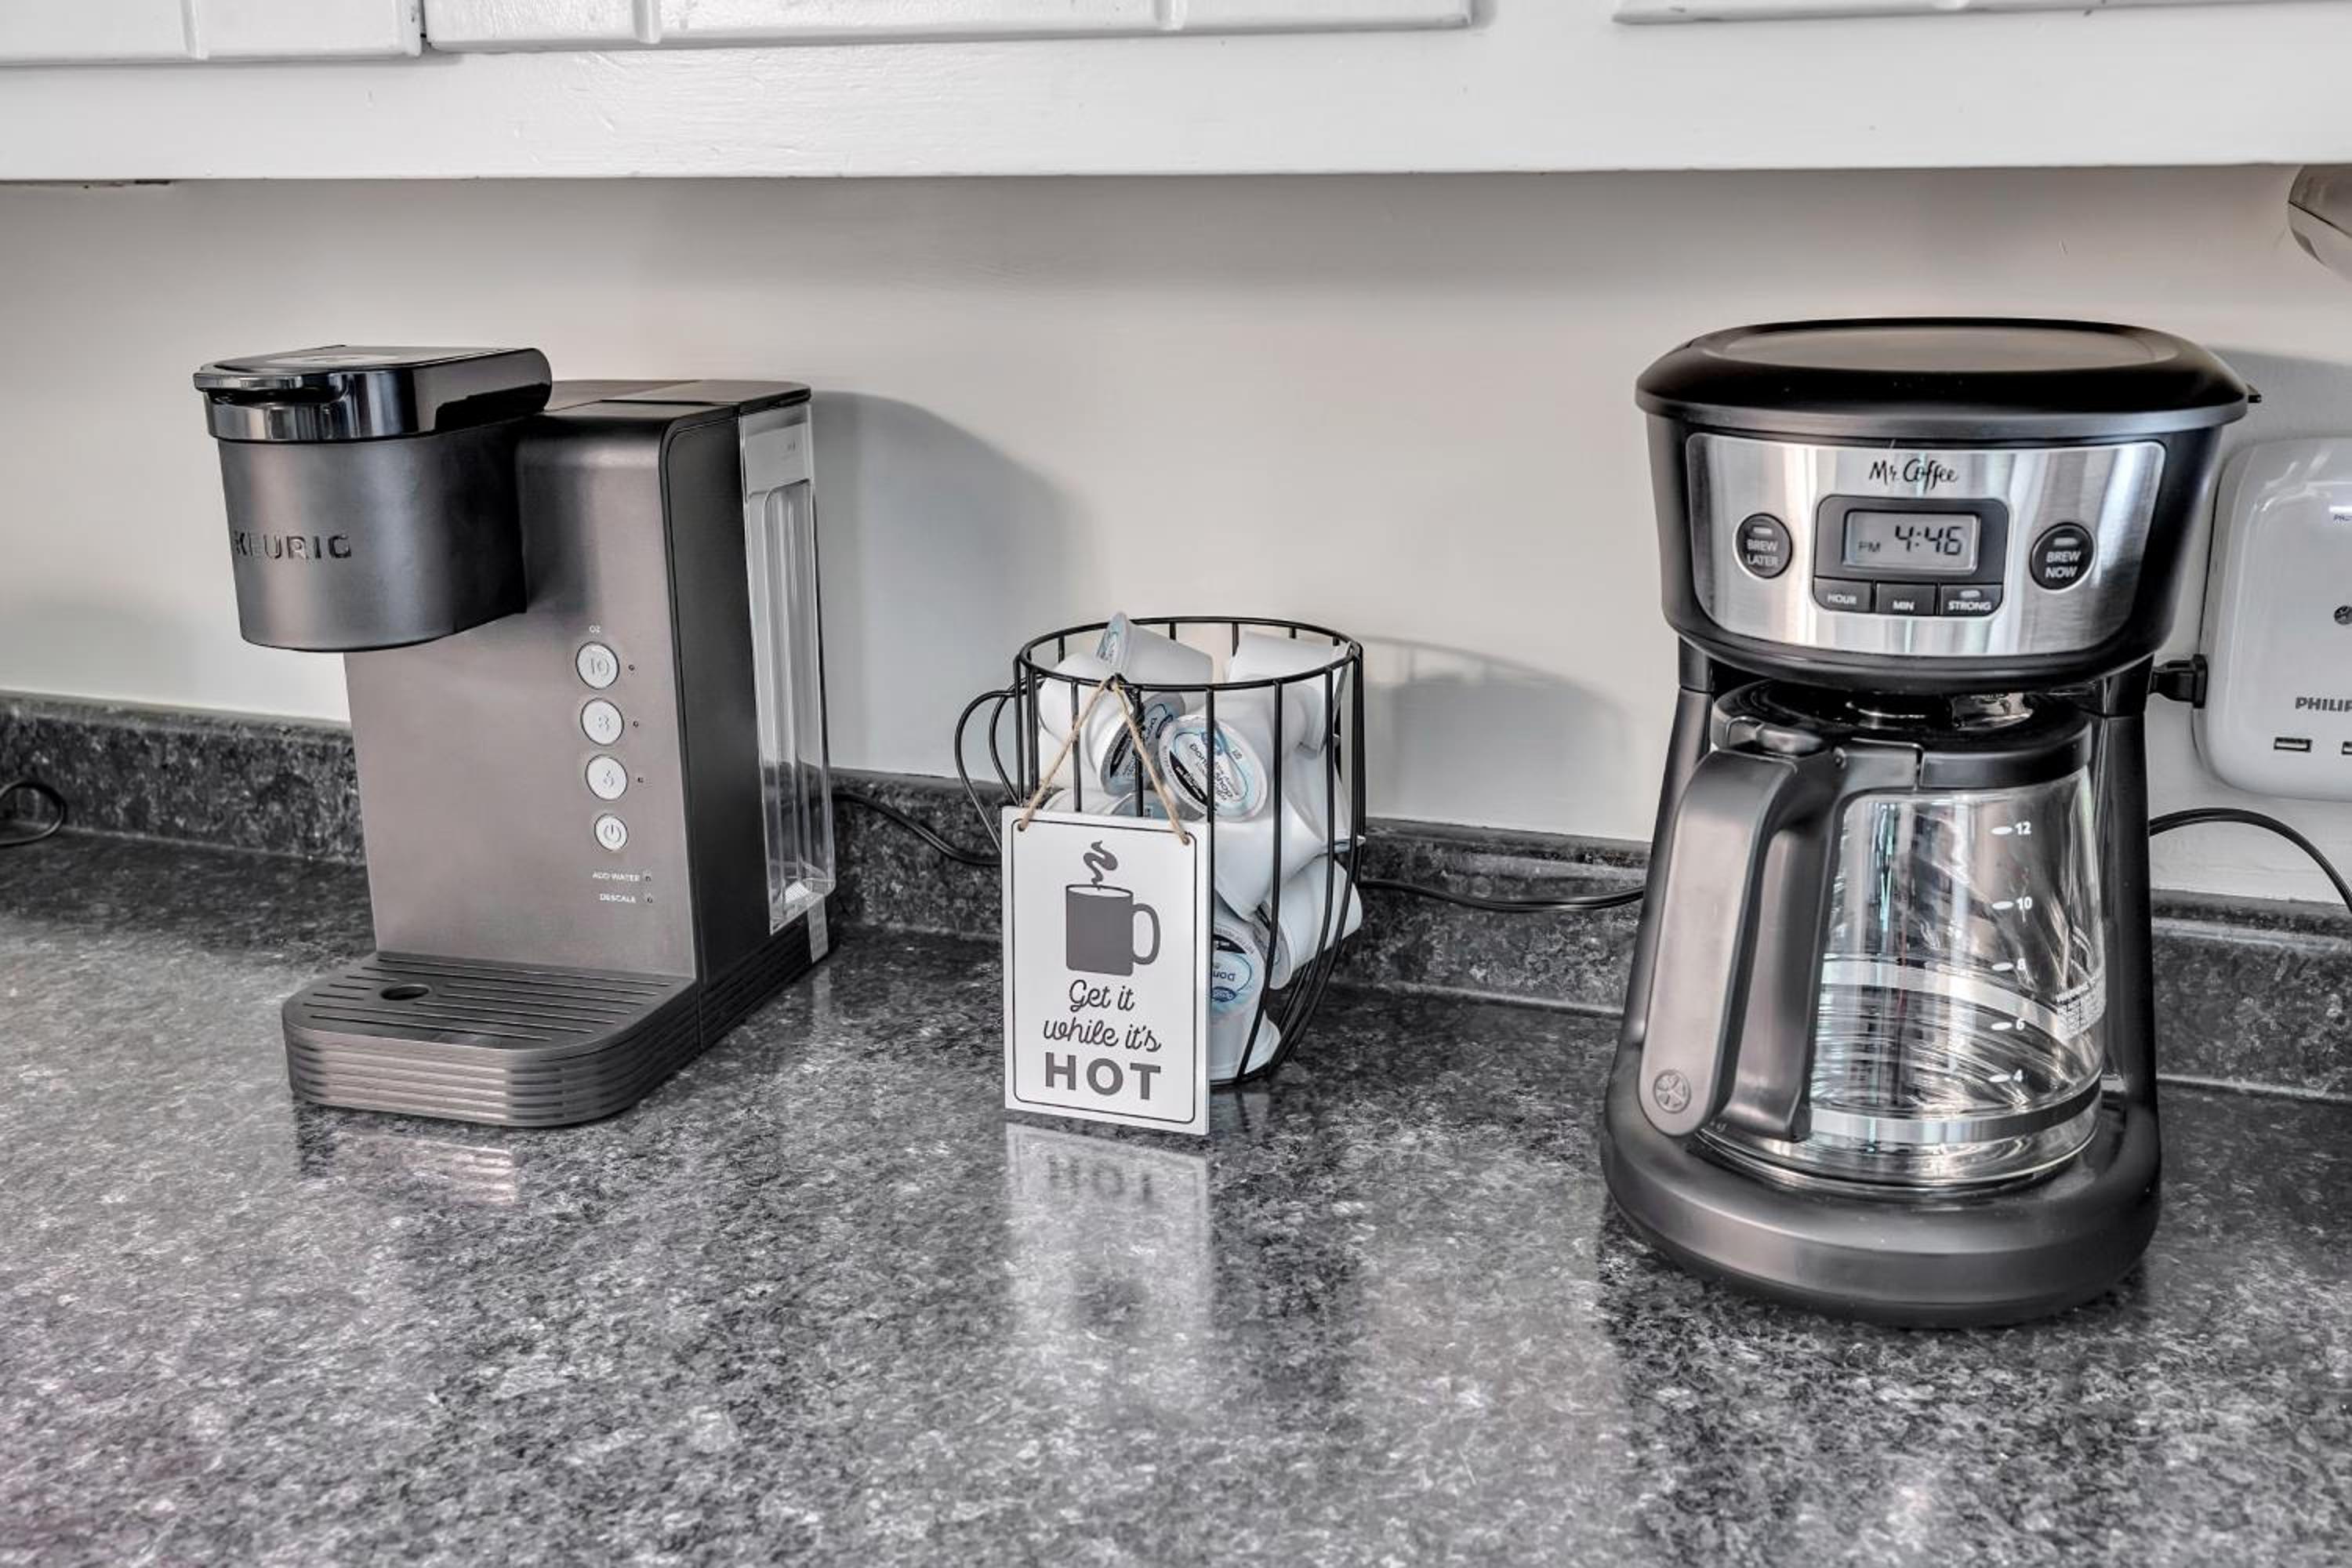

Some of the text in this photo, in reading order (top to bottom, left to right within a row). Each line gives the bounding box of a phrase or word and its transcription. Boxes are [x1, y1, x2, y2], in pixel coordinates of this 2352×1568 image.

[1903, 458, 1959, 494] Coffee
[1747, 539, 1779, 552] BREW
[1859, 525, 1962, 555] PM 4:46
[1747, 553, 1779, 568] LATER
[2046, 550, 2082, 563] BREW
[2045, 565, 2078, 578] NOW
[1828, 593, 1857, 604] HOUR
[1893, 601, 1915, 611] MIN
[1947, 600, 1992, 612] STRONG
[2014, 821, 2032, 836] 12
[2016, 896, 2033, 911] 10
[2016, 957, 2027, 971] 8
[1069, 978, 1135, 1013] Get it
[2015, 1018, 2026, 1032] 6
[1043, 1016, 1162, 1053] while it's
[1045, 1051, 1162, 1101] HOT
[2013, 1068, 2024, 1083] 4
